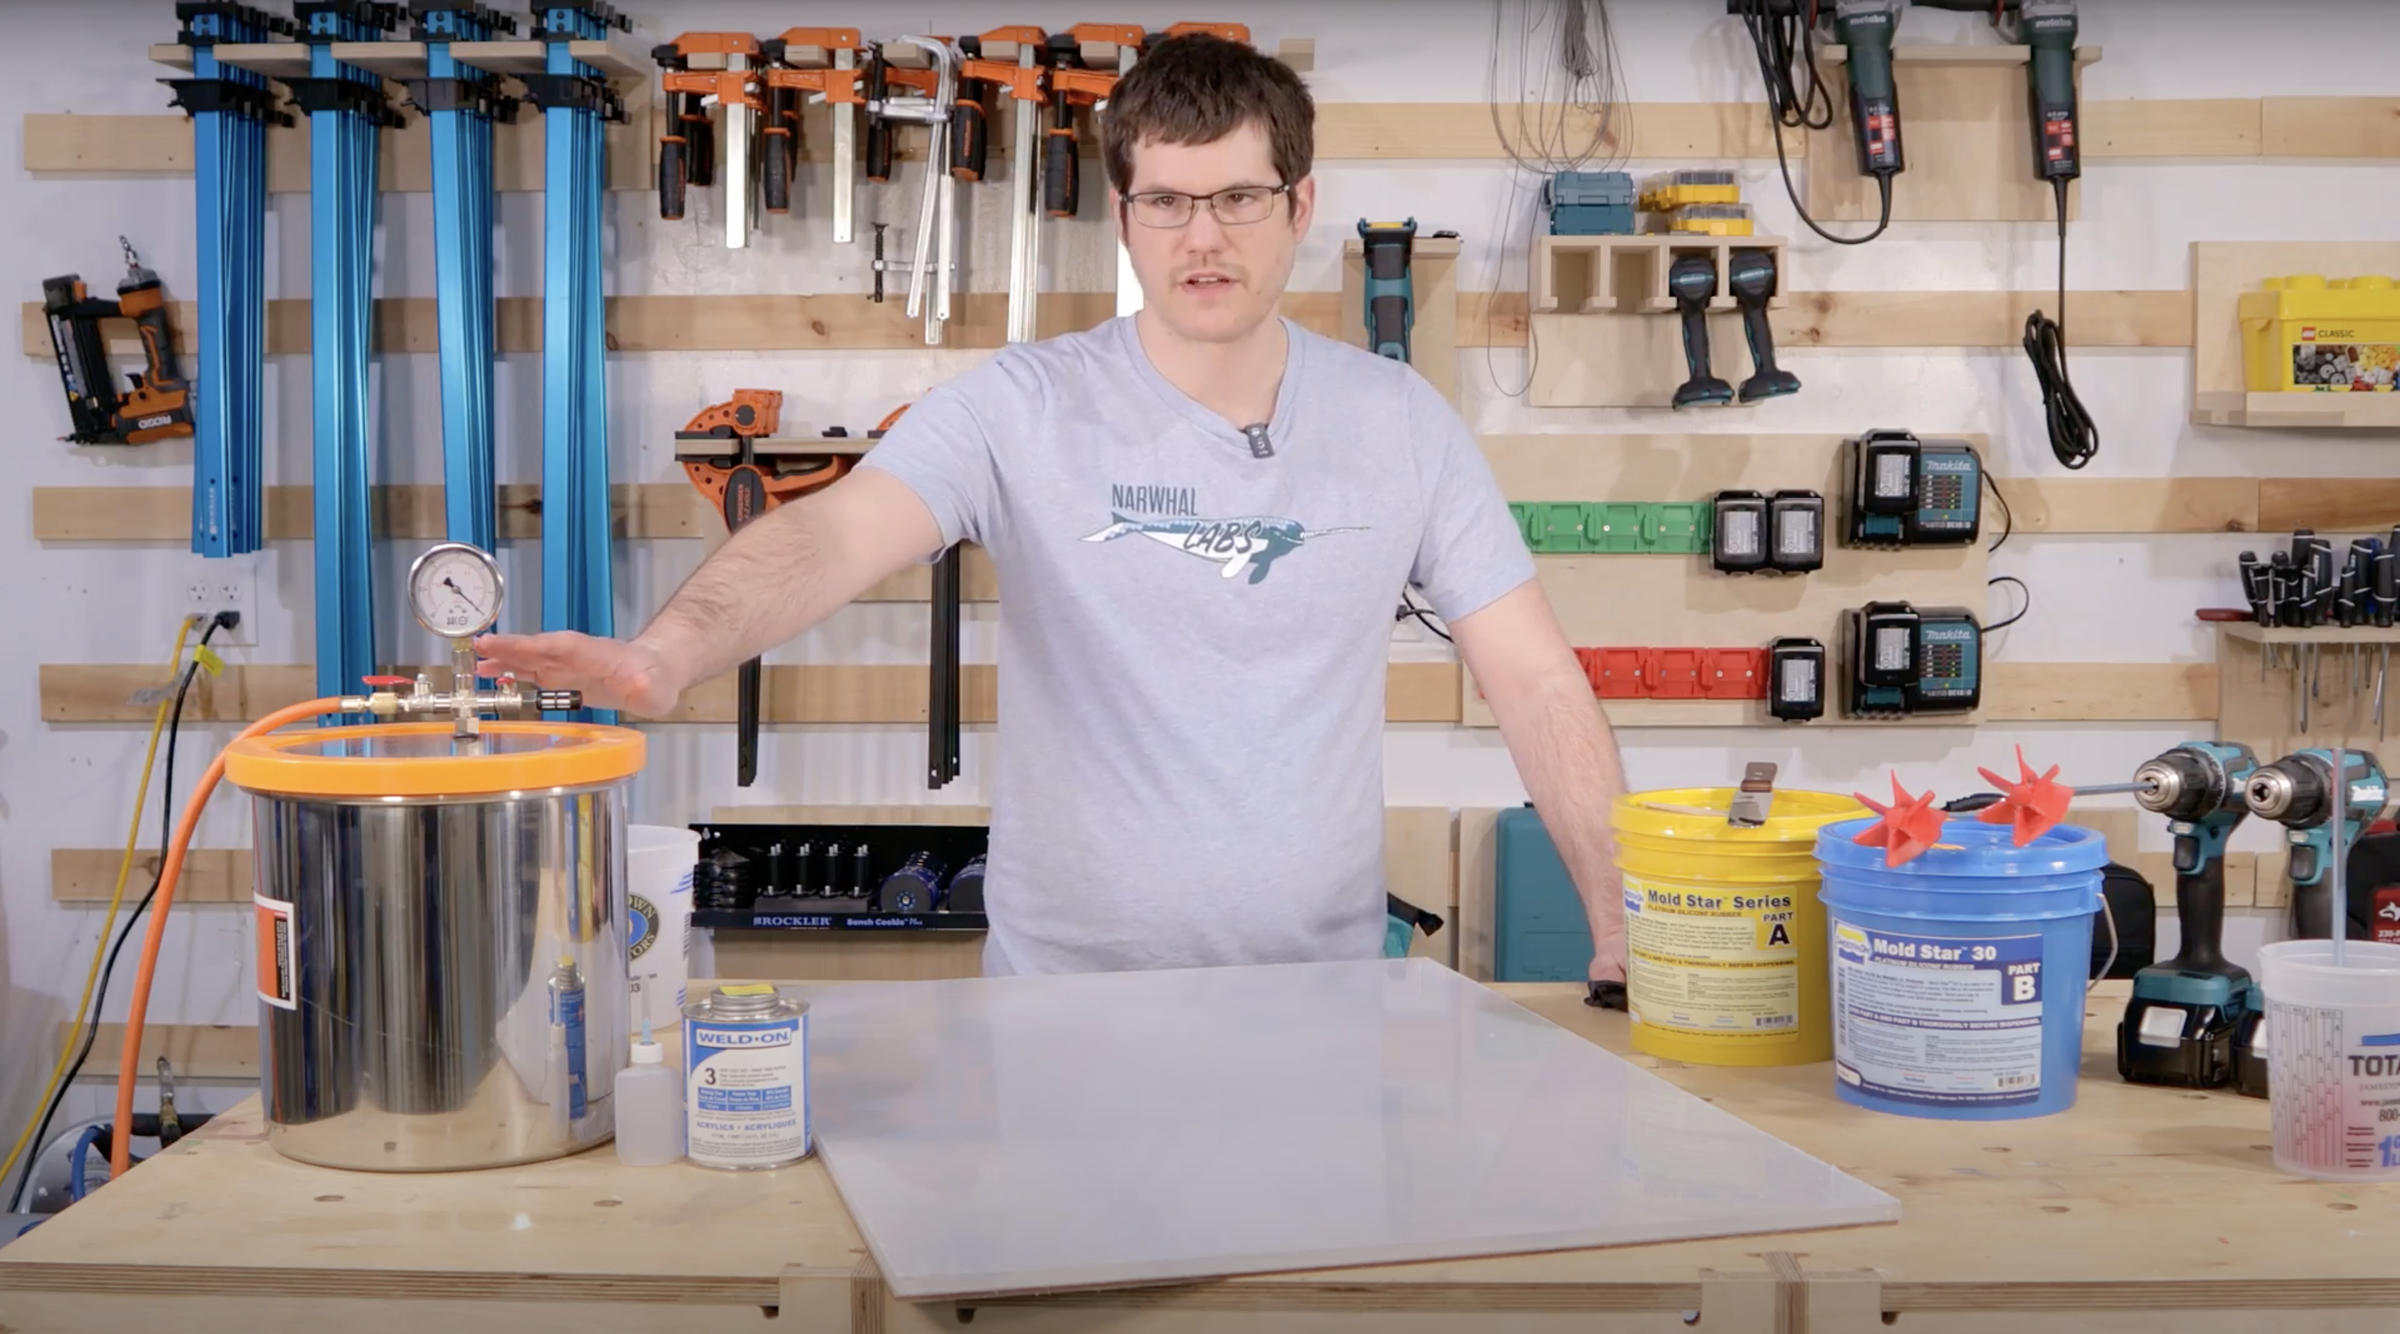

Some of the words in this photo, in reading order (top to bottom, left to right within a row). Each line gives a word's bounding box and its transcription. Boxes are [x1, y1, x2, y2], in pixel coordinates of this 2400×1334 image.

[1850, 15, 1887, 26] metabo
[2035, 18, 2073, 28] metabo
[2318, 329, 2355, 338] CLASSIC
[1111, 483, 1199, 517] NARWHAL
[1183, 520, 1264, 554] LABS
[1648, 889, 1681, 907] Mold
[1733, 895, 1791, 909] Series
[762, 916, 831, 926] ROCKLER
[1763, 912, 1794, 922] PART
[1768, 923, 1791, 946] A
[1873, 938, 1916, 958] Mold
[1972, 946, 1997, 961] 30
[2008, 962, 2041, 976] PART
[2014, 975, 2036, 1001] B
[2347, 1053, 2400, 1077] TOT
[704, 1067, 716, 1086] 3
[696, 1120, 735, 1132] ACRYLICS
[743, 1118, 797, 1132] ACRYLIQUES
